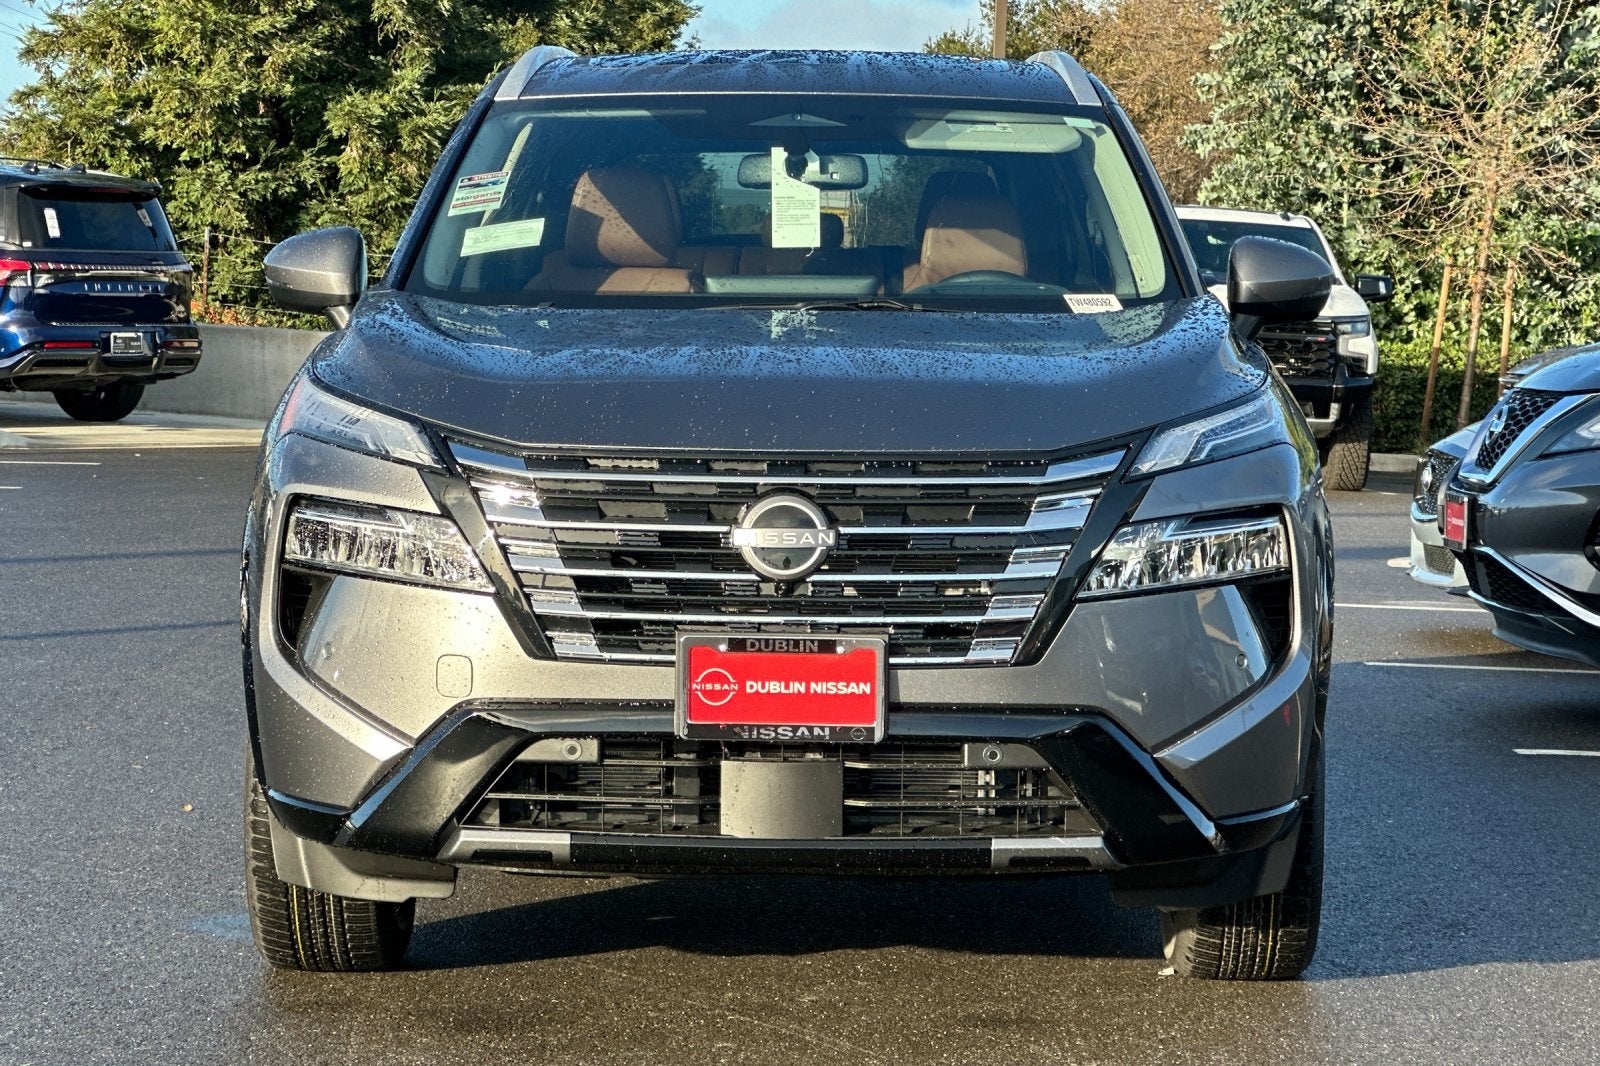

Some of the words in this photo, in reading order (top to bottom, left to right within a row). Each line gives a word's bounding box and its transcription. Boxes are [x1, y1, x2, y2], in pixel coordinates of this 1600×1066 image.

[1068, 297, 1114, 307] TW480592
[745, 638, 819, 653] DUBLIN
[692, 683, 739, 691] NISSAN
[745, 680, 806, 694] DUBLIN
[810, 681, 871, 695] NISSAN
[733, 725, 830, 740] NISSAN
